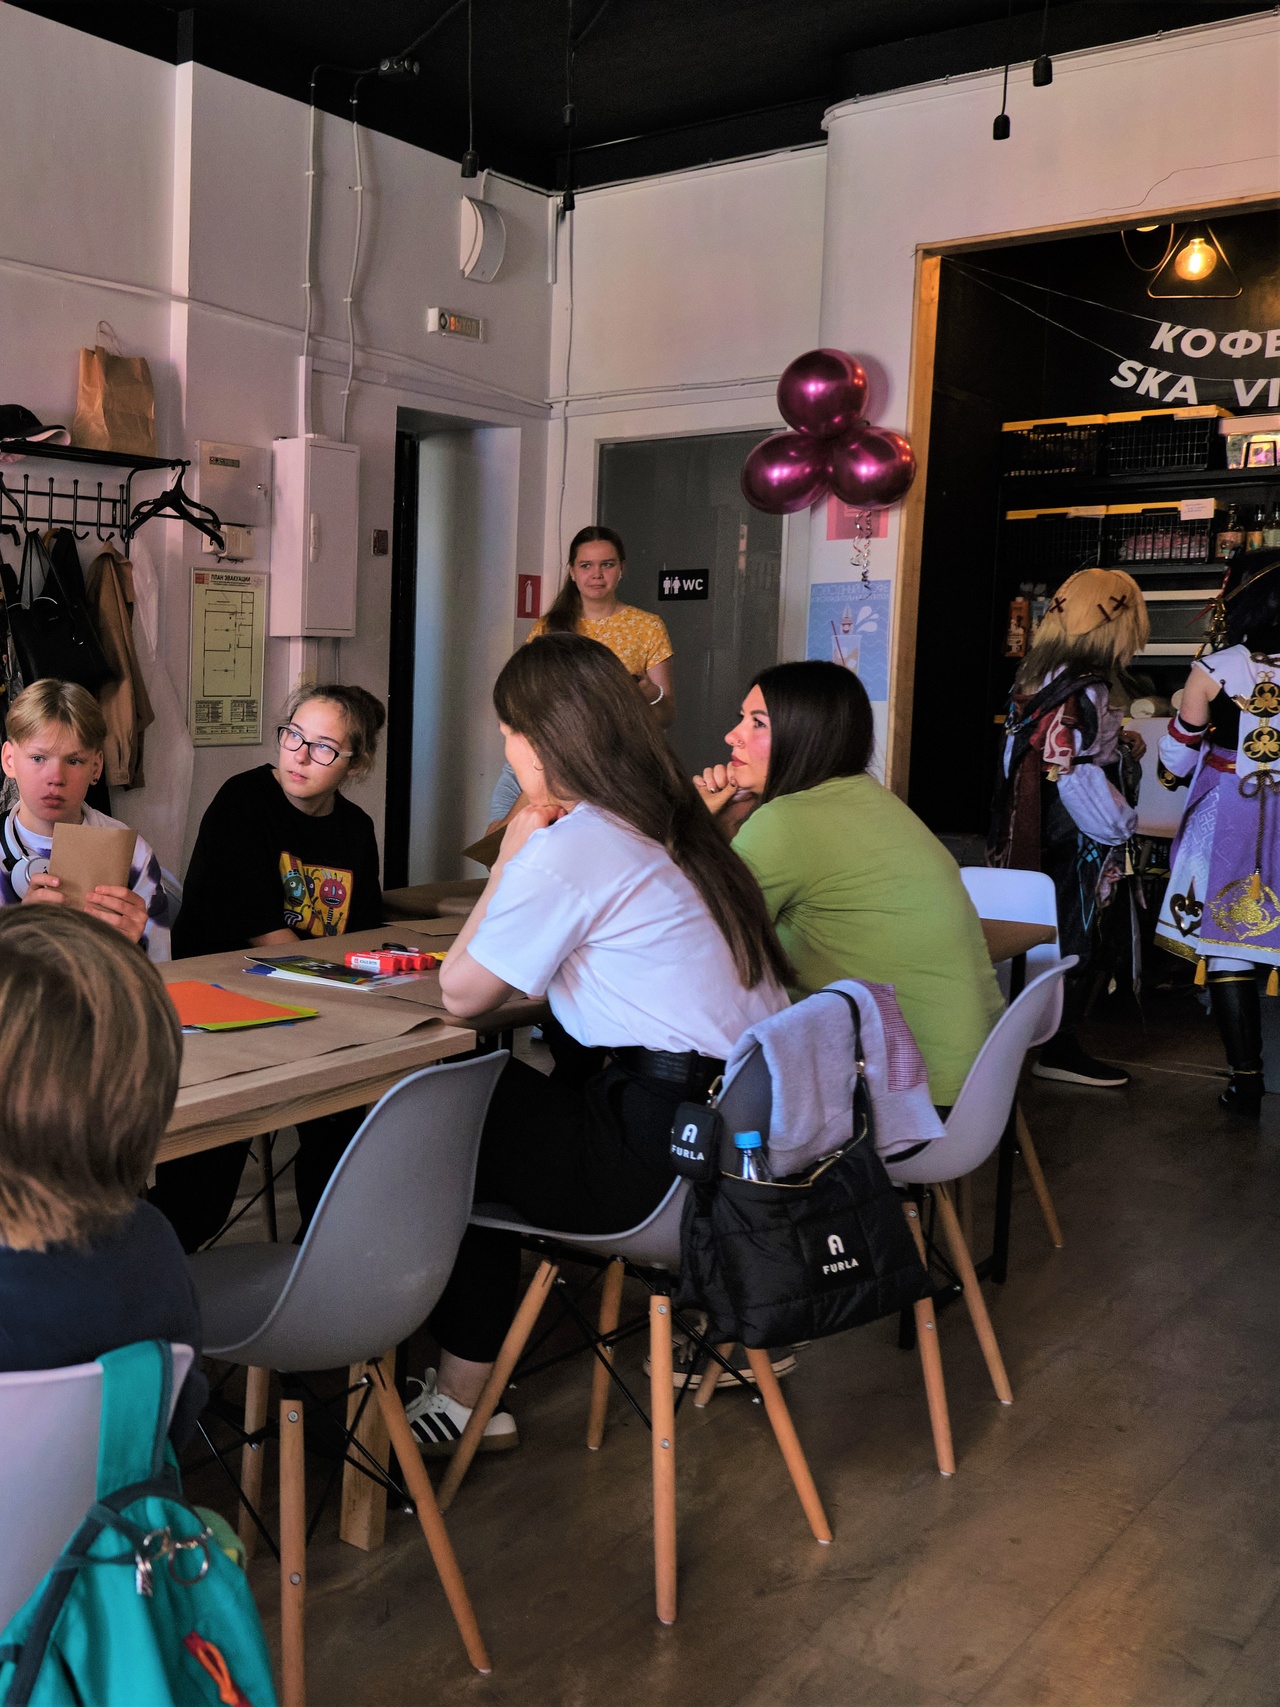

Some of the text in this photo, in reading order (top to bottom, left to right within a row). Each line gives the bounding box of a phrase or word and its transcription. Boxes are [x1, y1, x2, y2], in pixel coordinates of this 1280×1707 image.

[1110, 360, 1199, 405] SKA
[210, 573, 251, 582] ПЛАН ЭВАКУАЦИИ
[682, 579, 704, 591] WC
[671, 1144, 705, 1160] FURLA
[822, 1258, 859, 1275] FURLA
